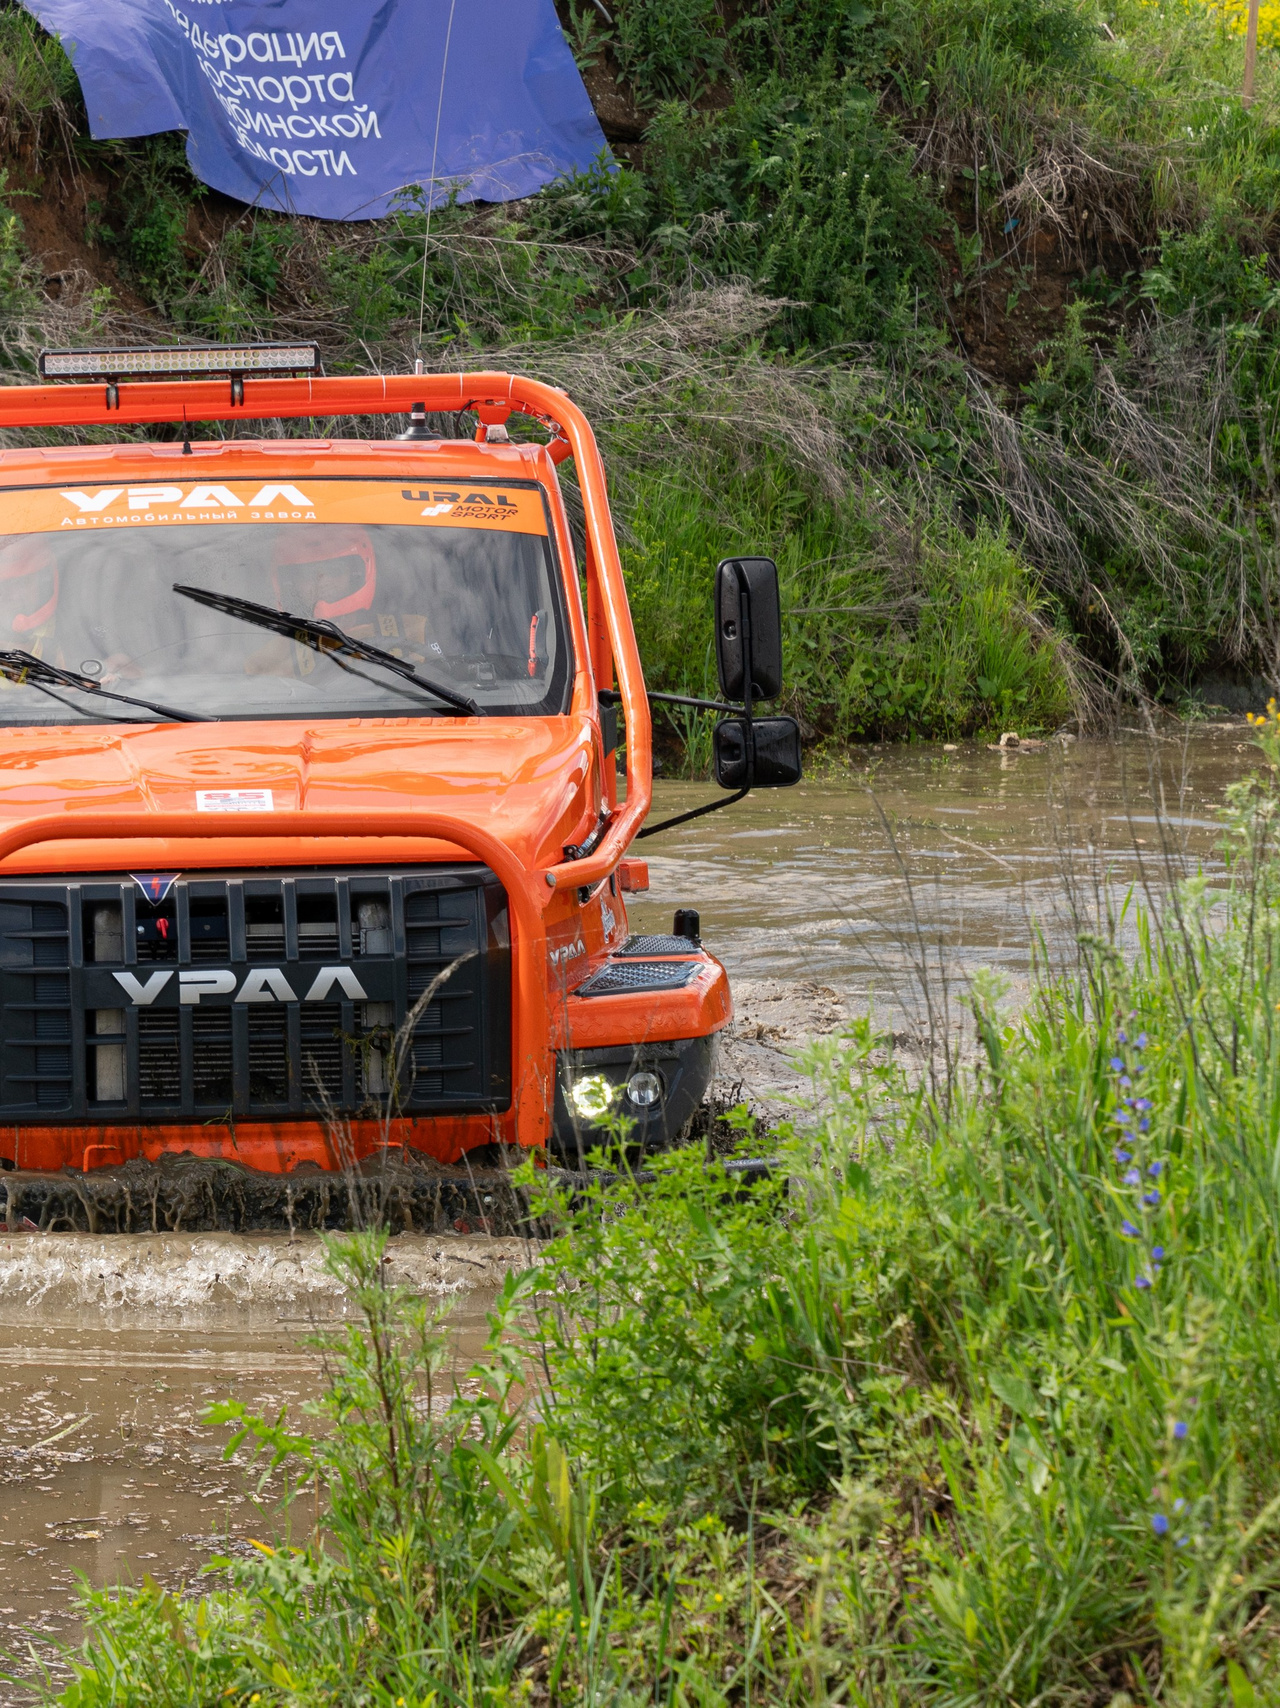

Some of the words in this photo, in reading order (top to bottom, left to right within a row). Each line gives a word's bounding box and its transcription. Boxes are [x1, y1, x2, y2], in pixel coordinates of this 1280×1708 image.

[59, 485, 315, 512] УРАЛ
[401, 490, 518, 507] URAL
[60, 510, 238, 526] Автомобильный
[250, 511, 317, 520] завод
[450, 512, 511, 521] SPORT
[455, 506, 519, 516] MOTOR
[550, 939, 586, 966] УРАЛ
[112, 967, 369, 1005] УРАЛ
